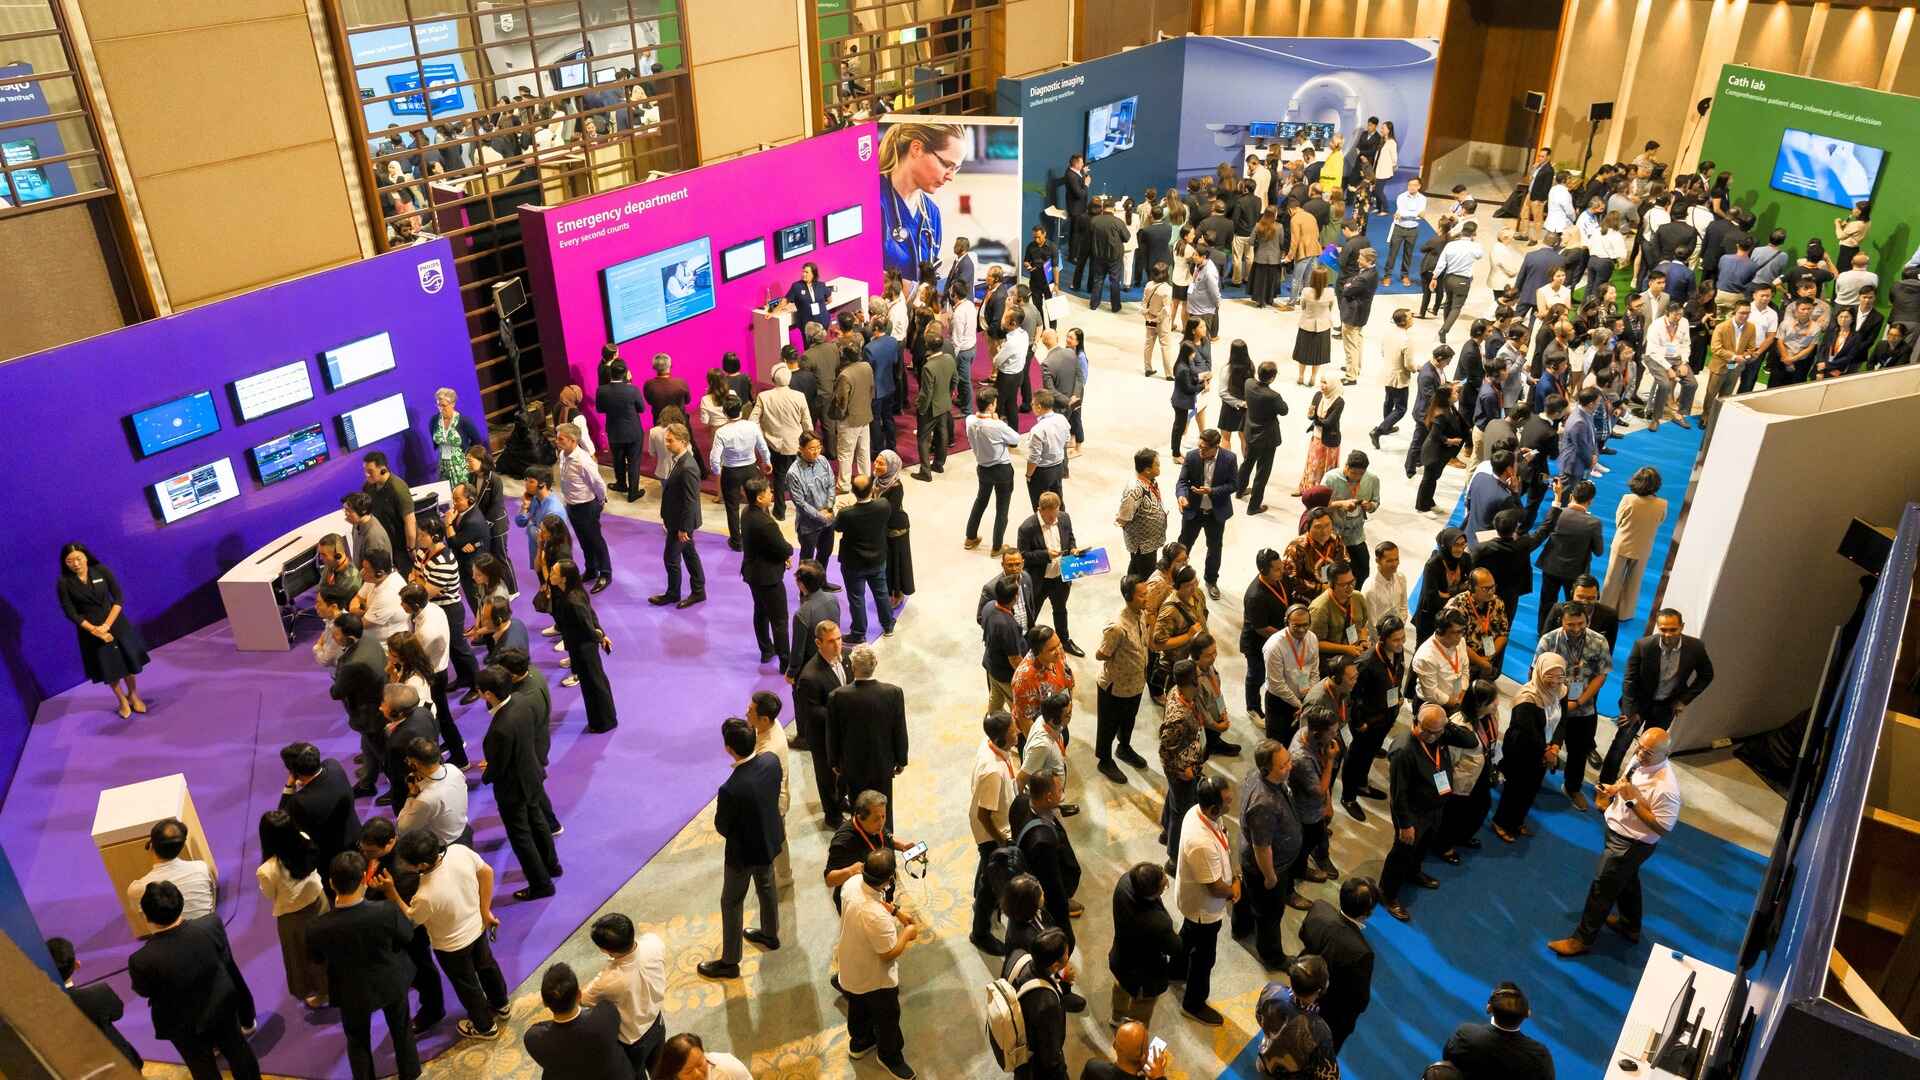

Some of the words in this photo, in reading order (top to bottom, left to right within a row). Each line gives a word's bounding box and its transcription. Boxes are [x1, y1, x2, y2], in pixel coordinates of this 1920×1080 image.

[1030, 81, 1061, 97] Diagnostic
[1061, 75, 1085, 88] imaging
[1728, 75, 1749, 88] Cath
[1751, 79, 1766, 91] lab
[1725, 88, 1767, 102] Comprehensive
[1767, 97, 1789, 107] patient
[1789, 102, 1803, 110] data
[1803, 104, 1832, 116] informed
[1833, 110, 1854, 121] clinical
[1855, 114, 1882, 126] decision
[557, 207, 621, 234] Emergency
[624, 187, 689, 214] department
[559, 237, 580, 249] Every
[581, 229, 606, 242] second
[607, 222, 630, 234] counts
